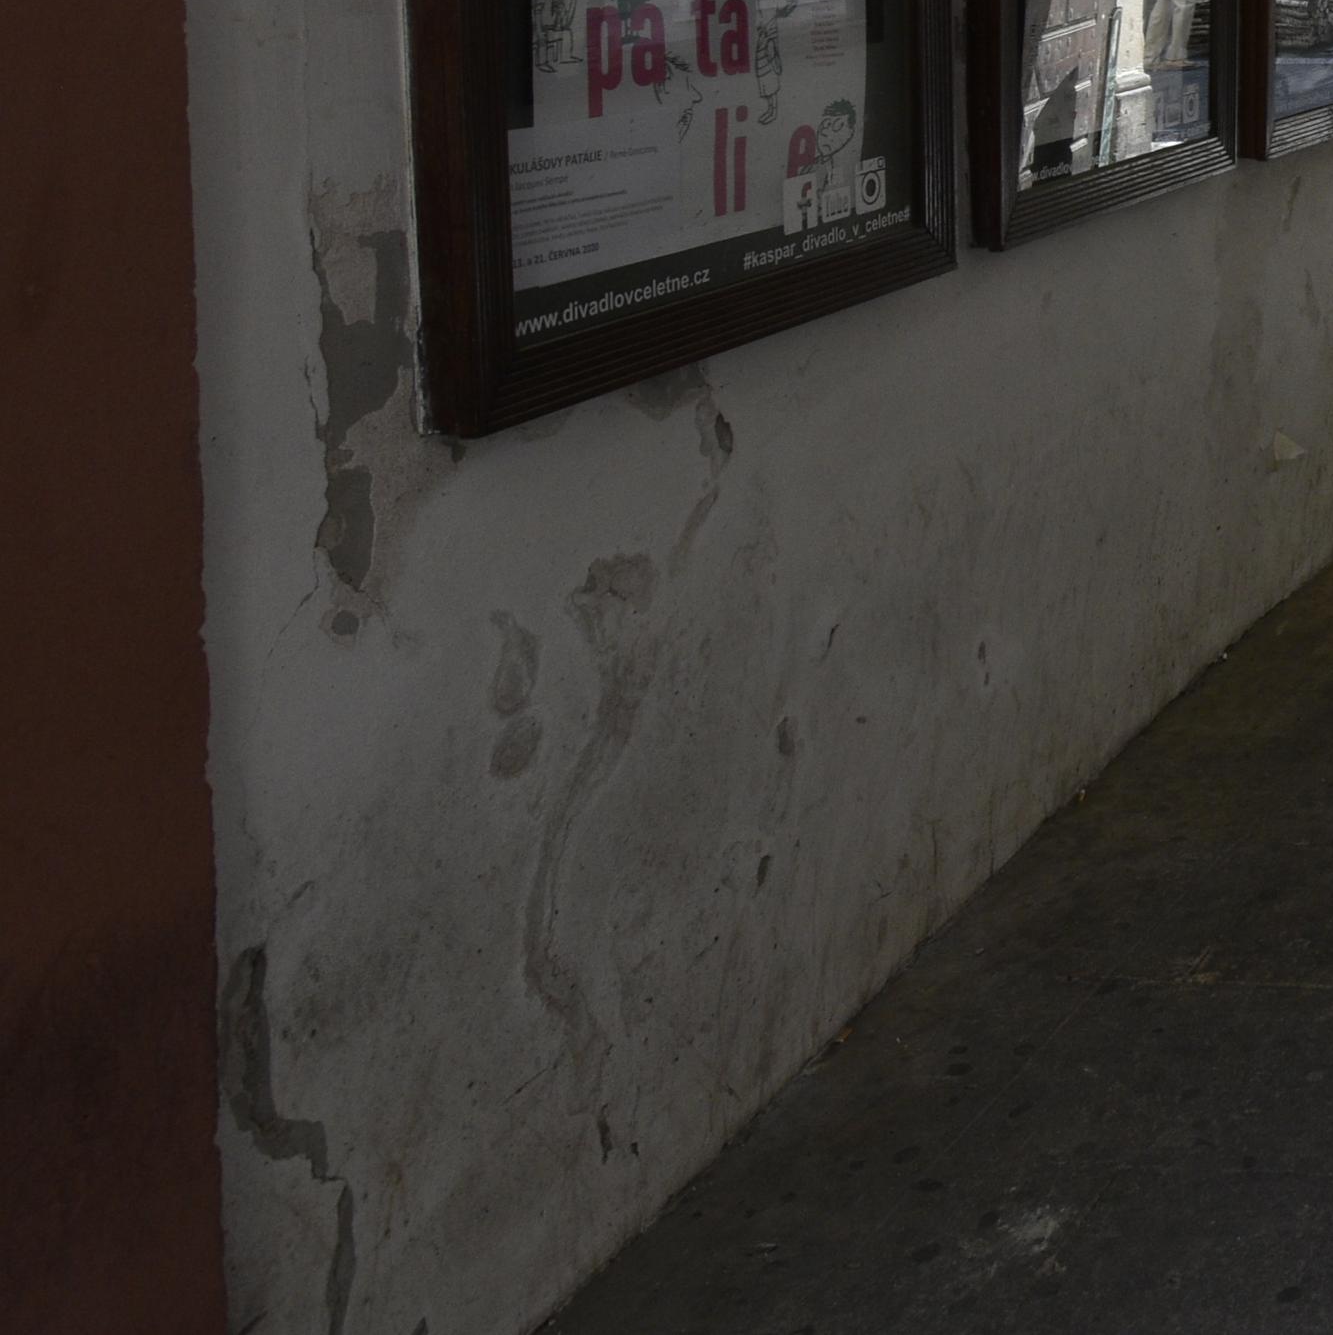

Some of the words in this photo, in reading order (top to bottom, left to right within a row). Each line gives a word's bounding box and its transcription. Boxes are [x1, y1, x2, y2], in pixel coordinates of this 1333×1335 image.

[586, 3, 666, 118] pa
[714, 105, 748, 217] li
[515, 267, 711, 337] www.divadlovceletne.cz
